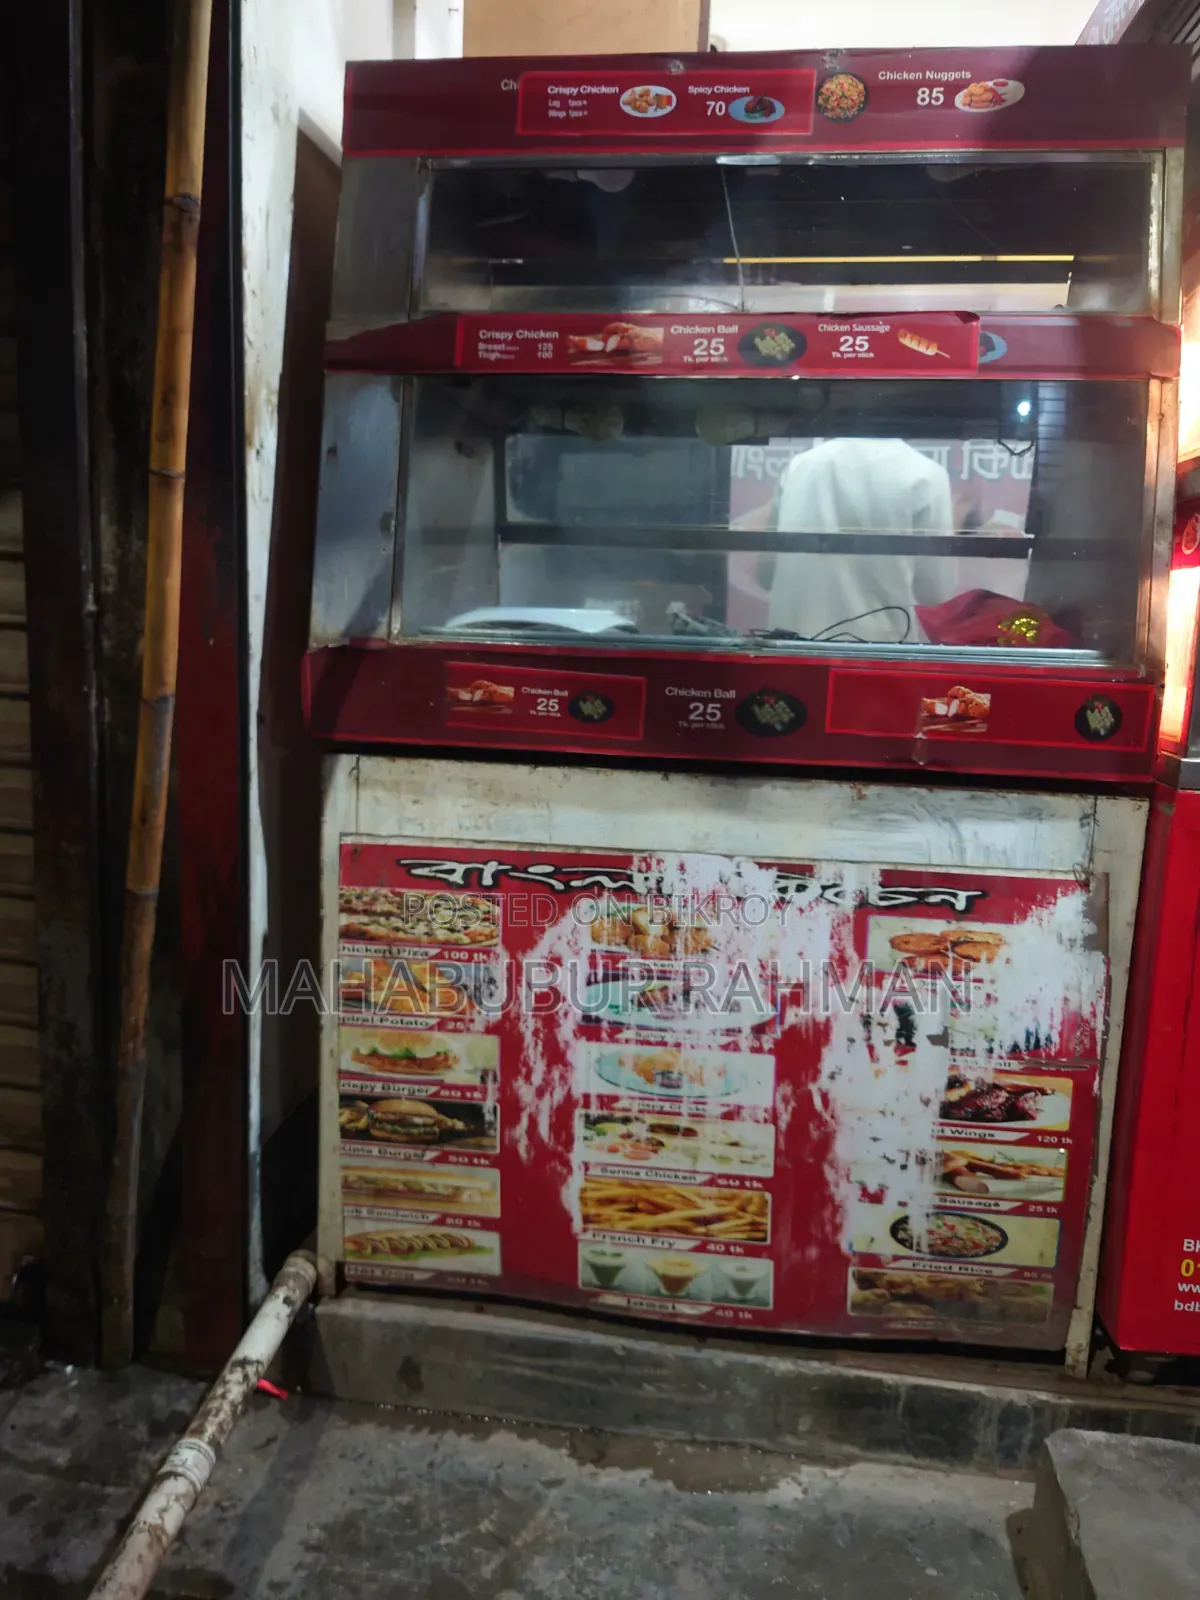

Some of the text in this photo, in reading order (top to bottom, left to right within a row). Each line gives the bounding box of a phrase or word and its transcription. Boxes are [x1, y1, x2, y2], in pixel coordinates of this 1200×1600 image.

[878, 69, 972, 81] Chicken Nuggets
[547, 84, 619, 96] Crispy Chicken
[688, 85, 750, 95] Spicy Chicken
[916, 87, 944, 106] 85
[705, 101, 726, 117] 70
[670, 324, 739, 336] Chicken Ball
[818, 323, 851, 333] Chicken
[479, 329, 559, 341] Crispy Chicken
[692, 338, 725, 356] 25
[839, 335, 870, 353] 25
[521, 686, 569, 698] Chicken Ball
[664, 686, 736, 700] Chicken Ball
[535, 697, 560, 711] 25
[688, 701, 722, 722] 25
[340, 944, 393, 957] hicken
[442, 950, 488, 962] 100 tk
[379, 1016, 430, 1028] Potato
[340, 1080, 432, 1096] rispy Burger
[950, 1128, 996, 1139] Wings
[1036, 1134, 1074, 1145] 120 tk
[645, 1168, 697, 1182] Chicken
[744, 1178, 764, 1189] tk
[1046, 1204, 1058, 1213] tk
[590, 1230, 677, 1249] French Fry
[706, 1242, 745, 1254] 40 tk
[911, 1261, 953, 1271] Fried
